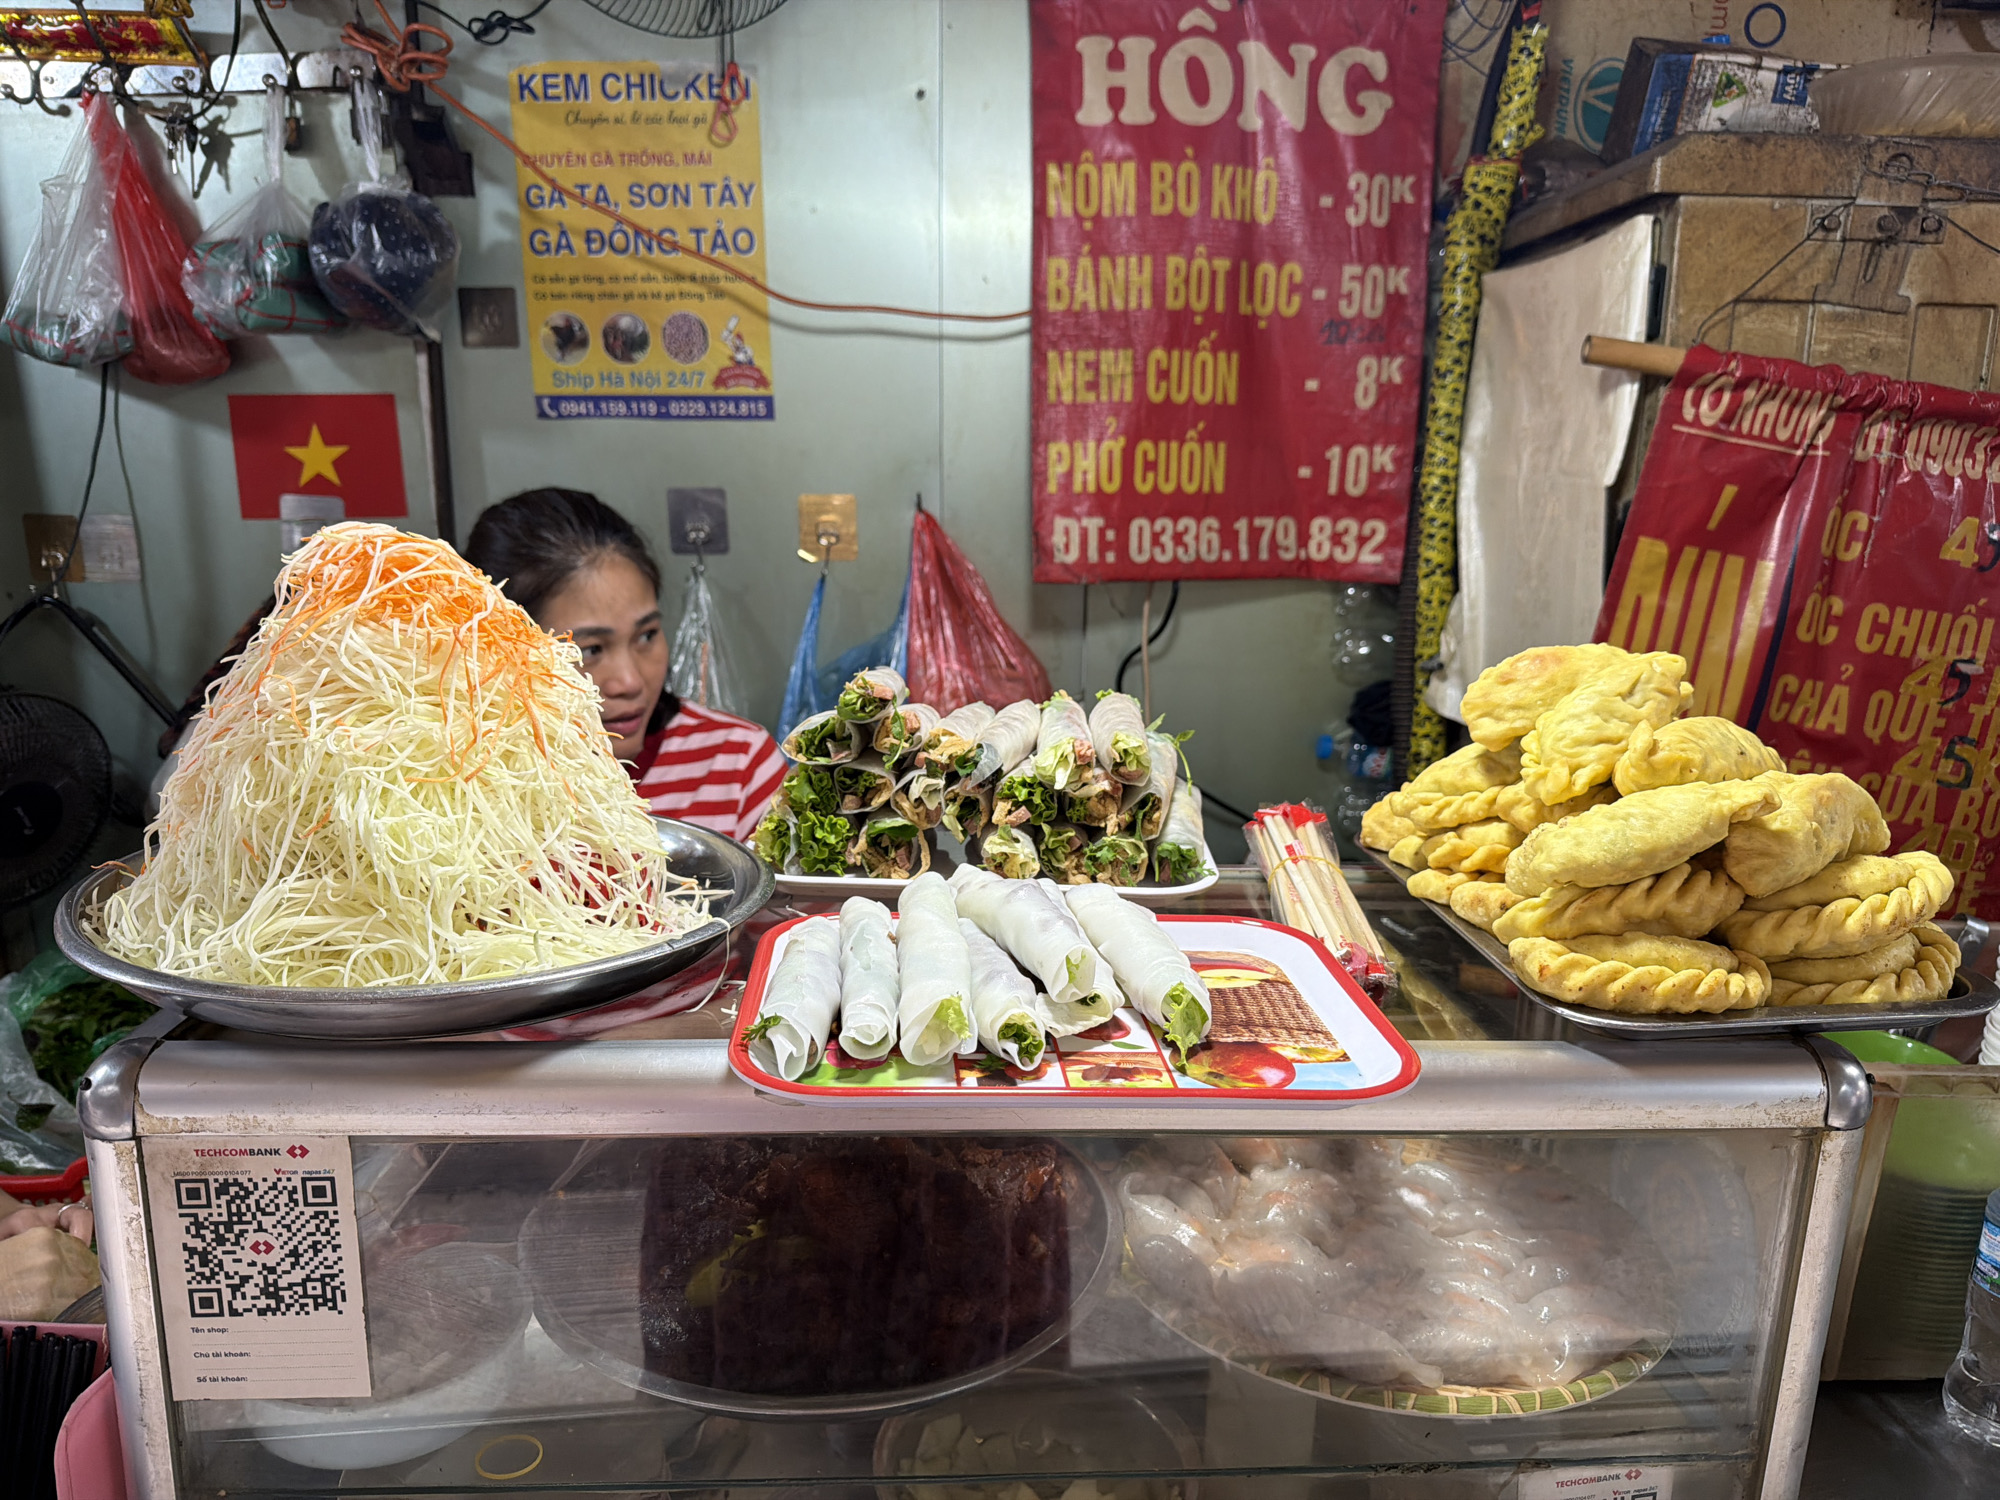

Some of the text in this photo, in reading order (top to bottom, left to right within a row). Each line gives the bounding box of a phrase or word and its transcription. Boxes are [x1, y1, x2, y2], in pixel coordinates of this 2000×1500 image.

[518, 72, 591, 102] KEM
[1075, 0, 1393, 136] HỒNG
[525, 178, 568, 210] GÀ
[628, 181, 691, 209] SƠN
[700, 175, 756, 208] TÂY
[1046, 149, 1137, 231] NỘM
[1150, 146, 1201, 218] BÒ
[1211, 157, 1279, 226] KHÔ
[1345, 171, 1417, 228] 30K
[529, 219, 757, 257] GÀ ĐÔNG TẢO
[1046, 243, 1153, 313] BÁNH
[1165, 245, 1232, 325] BỘT
[1239, 259, 1303, 329] LỌC
[1338, 264, 1411, 320] 50K
[552, 371, 594, 391] Ship
[601, 371, 625, 388] Hà
[629, 371, 661, 389] Nội
[667, 371, 706, 389] 24/7
[1046, 348, 1135, 405] NEM
[1146, 331, 1239, 406] CUỐN
[1354, 356, 1405, 411] 8K
[1046, 416, 1127, 495] PHỞ
[1133, 421, 1228, 495] CUỐN
[1325, 445, 1397, 498] 10K
[1906, 418, 2000, 484] 0903
[1052, 515, 1388, 565] ĐT: 0336.179.832
[1768, 663, 1855, 735] CHẢ
[193, 1148, 282, 1158] TECHCOMBANK
[207, 1327, 229, 1335] shop:
[1555, 1472, 1622, 1489] TECHCOMBANK
